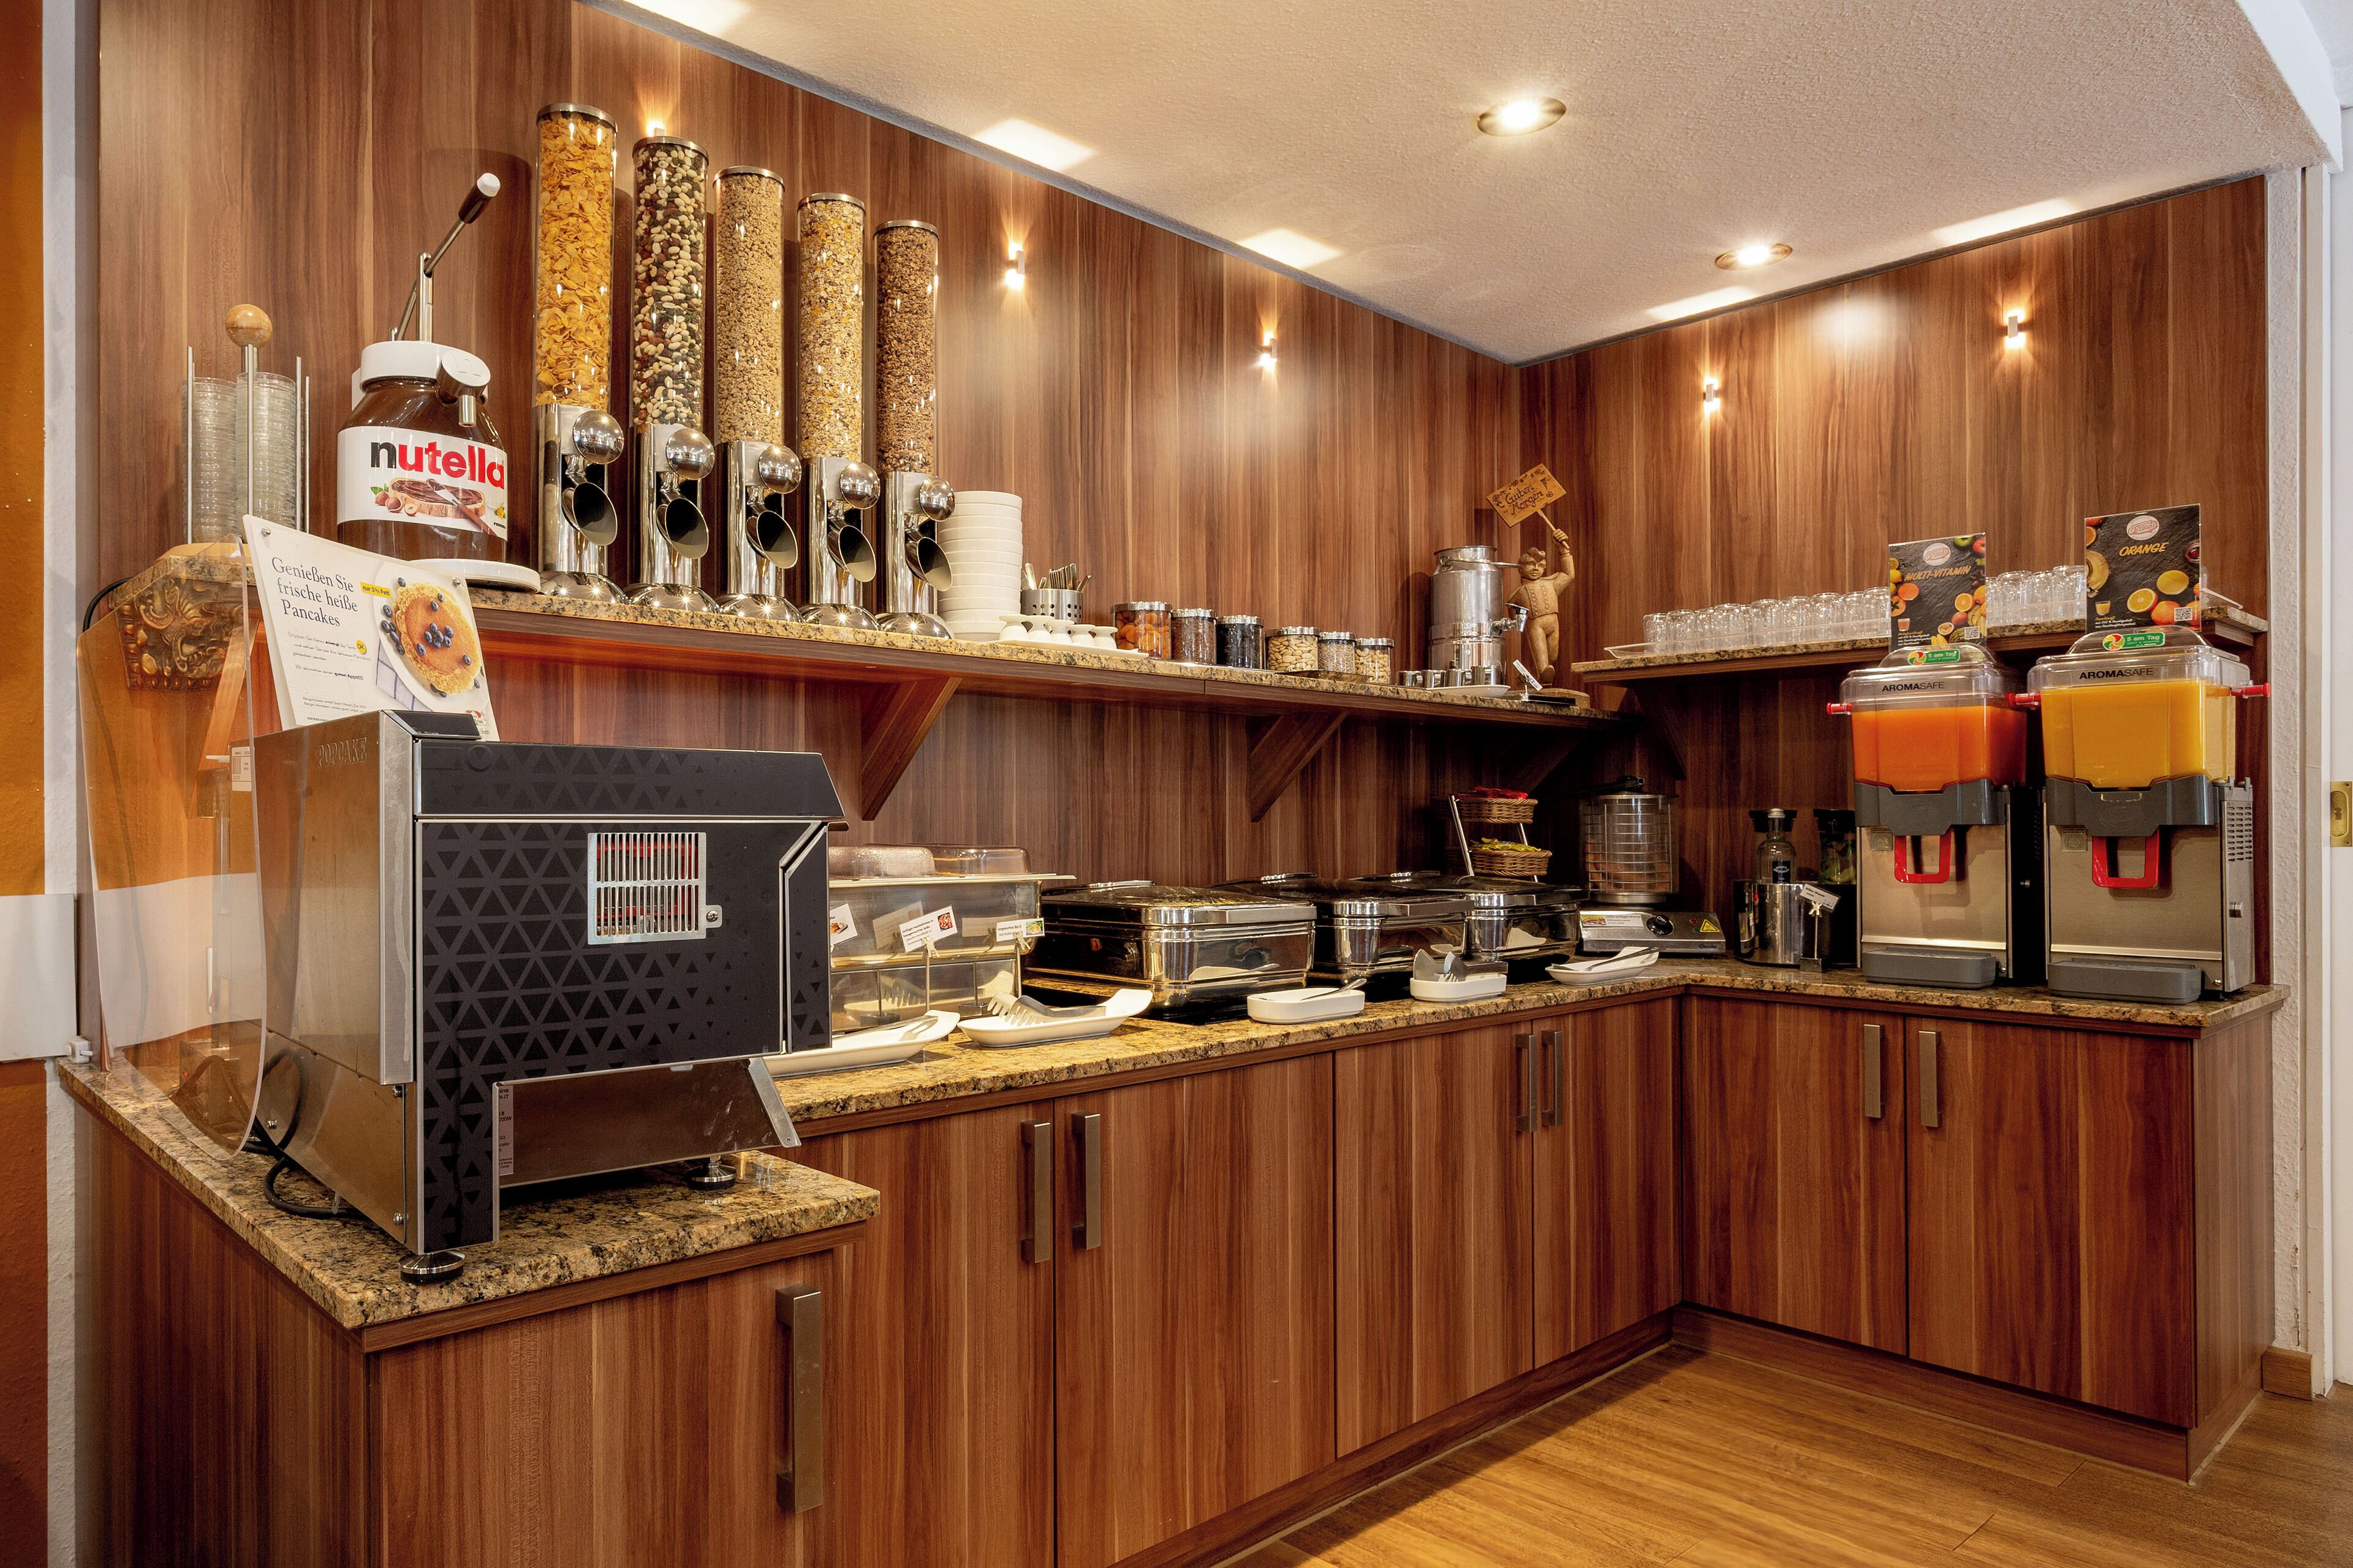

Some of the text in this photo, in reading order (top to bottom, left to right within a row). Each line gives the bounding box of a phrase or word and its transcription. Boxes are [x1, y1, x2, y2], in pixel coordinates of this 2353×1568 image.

[371, 441, 505, 490] nutella
[1510, 490, 1544, 515] Morgen
[2118, 542, 2169, 556] ORANGE
[271, 557, 354, 593] Genießen Sie
[1904, 566, 1972, 581] MULTI-VITAMIN
[277, 577, 358, 612] frische heiße
[281, 598, 341, 627] Pancakes
[1882, 681, 1944, 692] AROMASAFE
[2079, 667, 2154, 680] AROMASAFE
[318, 737, 367, 768] POPCAKE
